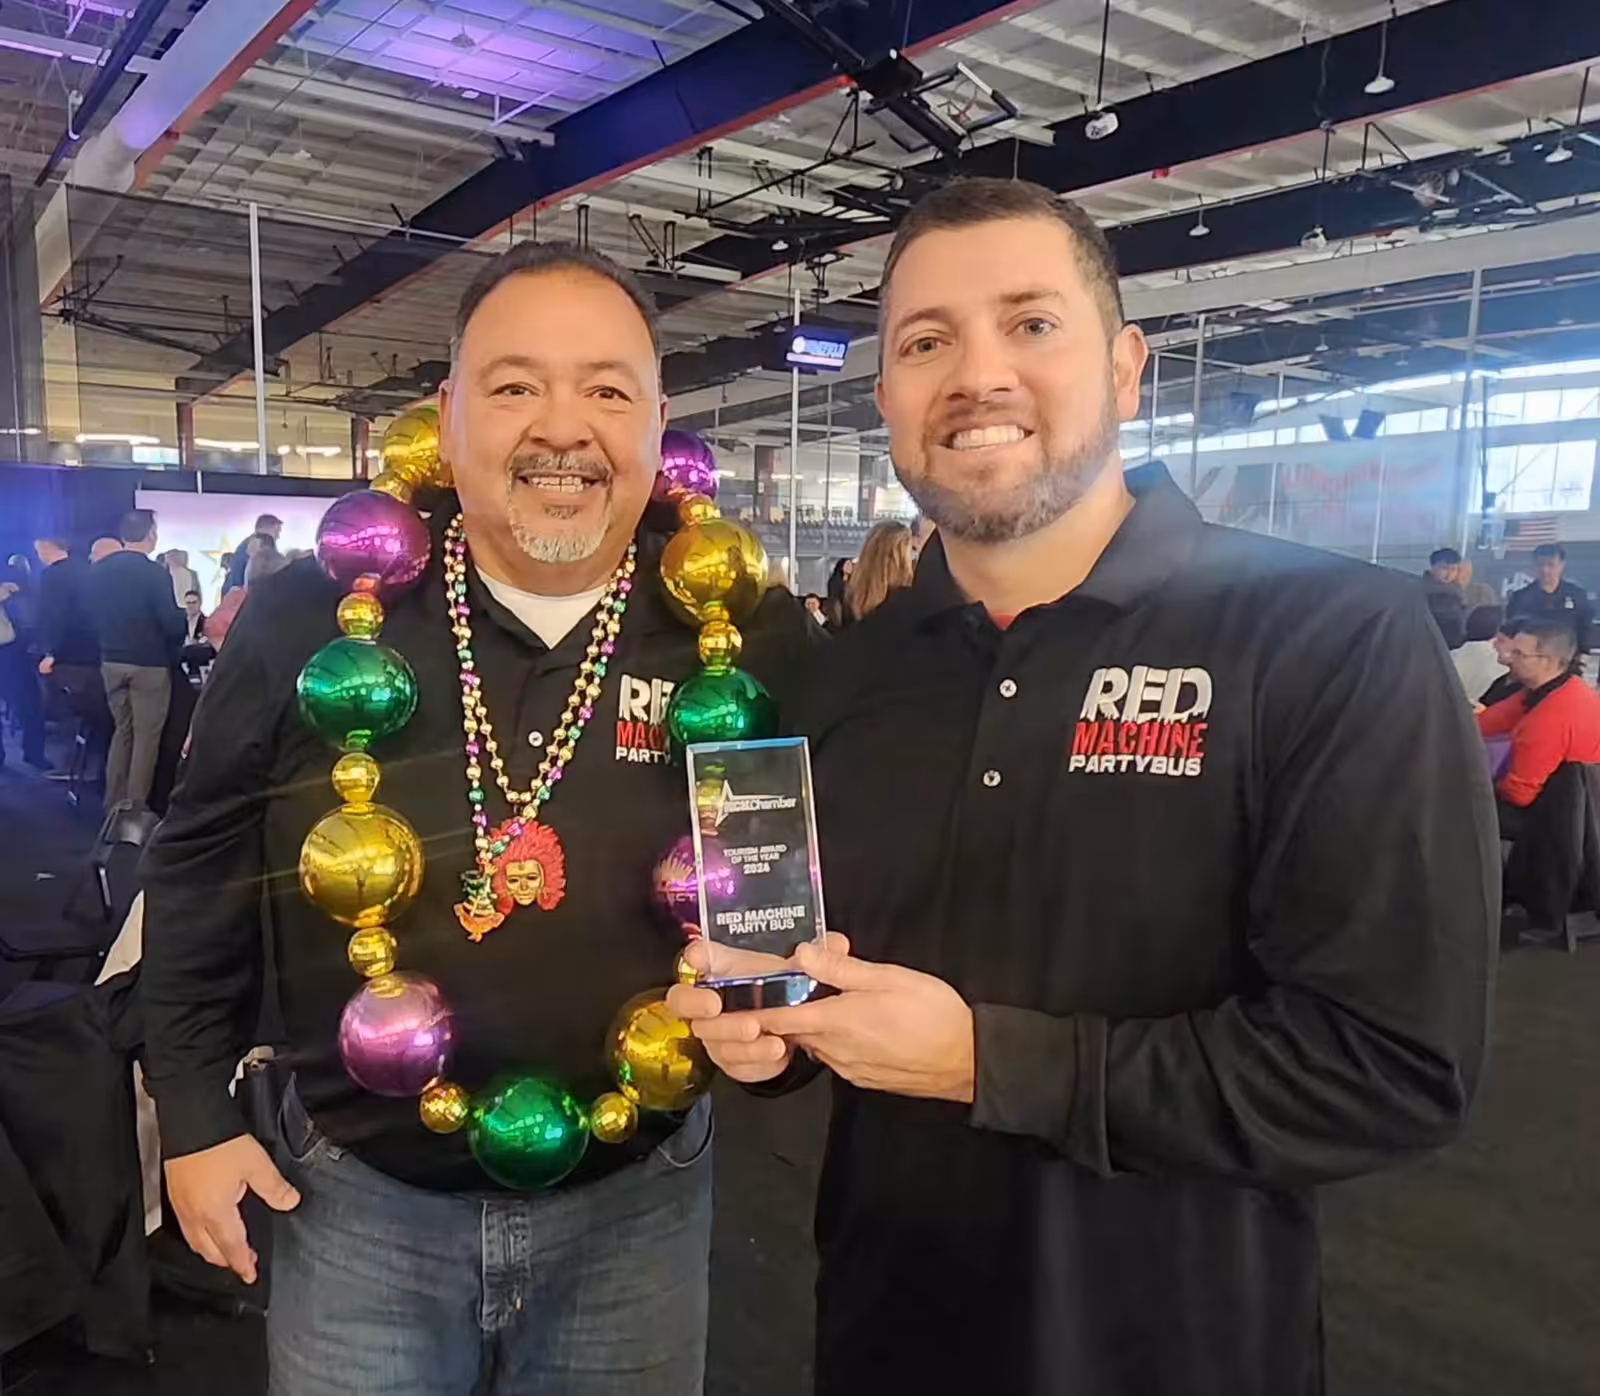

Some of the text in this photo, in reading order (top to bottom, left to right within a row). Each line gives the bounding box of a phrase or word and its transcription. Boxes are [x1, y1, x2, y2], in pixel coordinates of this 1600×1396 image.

[1080, 665, 1212, 724] RED
[1072, 720, 1207, 758] MACHINE
[731, 852, 780, 864] OF THE YEAR
[716, 905, 805, 925] RED MACHINE
[729, 918, 795, 935] PARTY BUS
